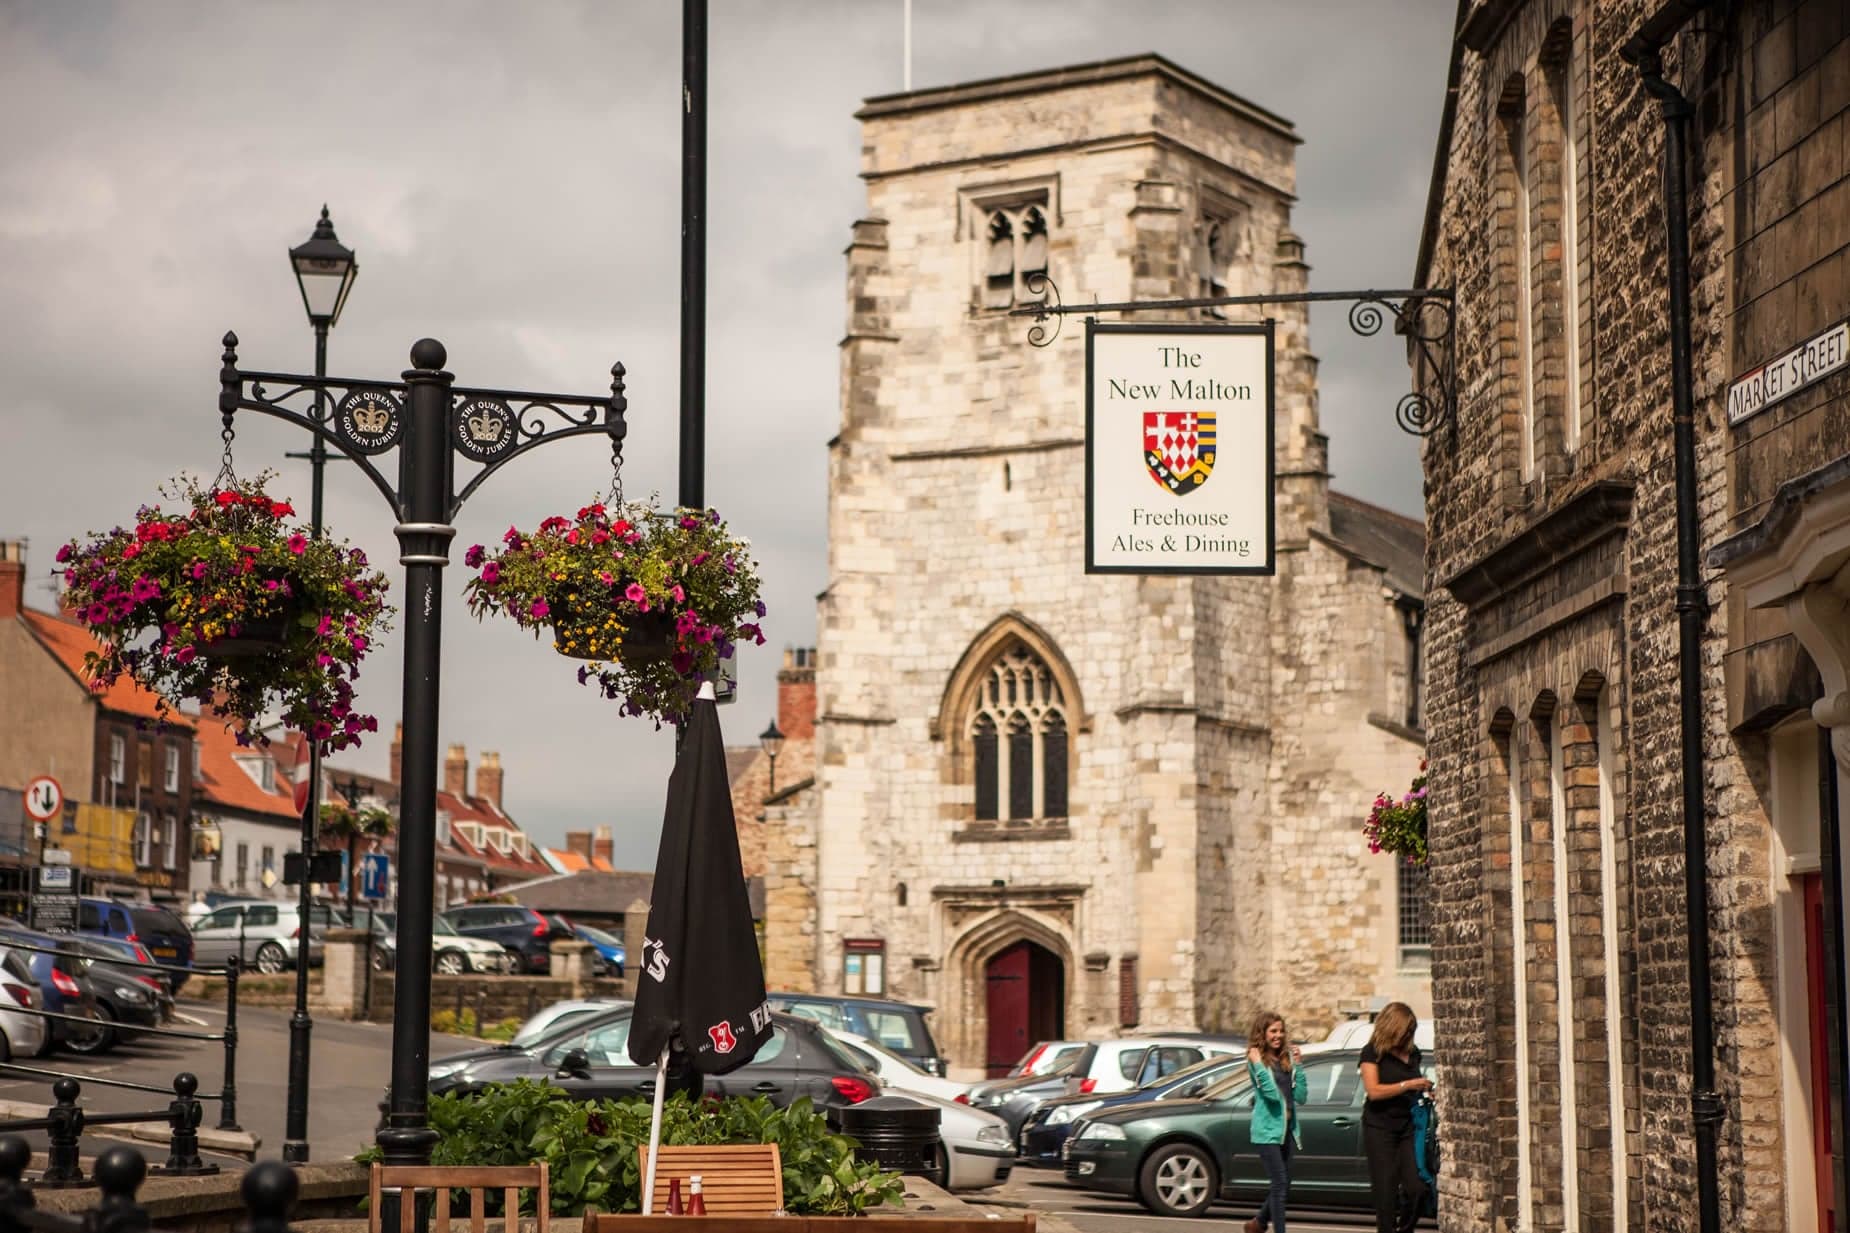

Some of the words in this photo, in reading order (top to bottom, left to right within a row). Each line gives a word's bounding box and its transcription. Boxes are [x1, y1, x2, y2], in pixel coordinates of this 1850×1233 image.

[1158, 347, 1202, 368] The
[1732, 361, 1785, 418] MARKET
[1791, 330, 1844, 385] STREET
[1108, 379, 1161, 400] New
[1170, 378, 1252, 401] Malton
[345, 395, 362, 411] THE
[363, 391, 396, 414] QUEEN'S
[461, 404, 476, 419] THE
[477, 400, 510, 421] QUEEN'S
[343, 416, 369, 447] GOLDEN
[370, 420, 399, 448] JUBILEE
[358, 424, 384, 433] 2002
[458, 424, 484, 454] GOLDEN
[486, 428, 513, 455] JUBILEE
[474, 432, 498, 442] 2002
[1132, 508, 1229, 526] Freehouse
[1111, 534, 1154, 552] Ales
[1161, 534, 1179, 552] &
[1185, 534, 1250, 557] Dining
